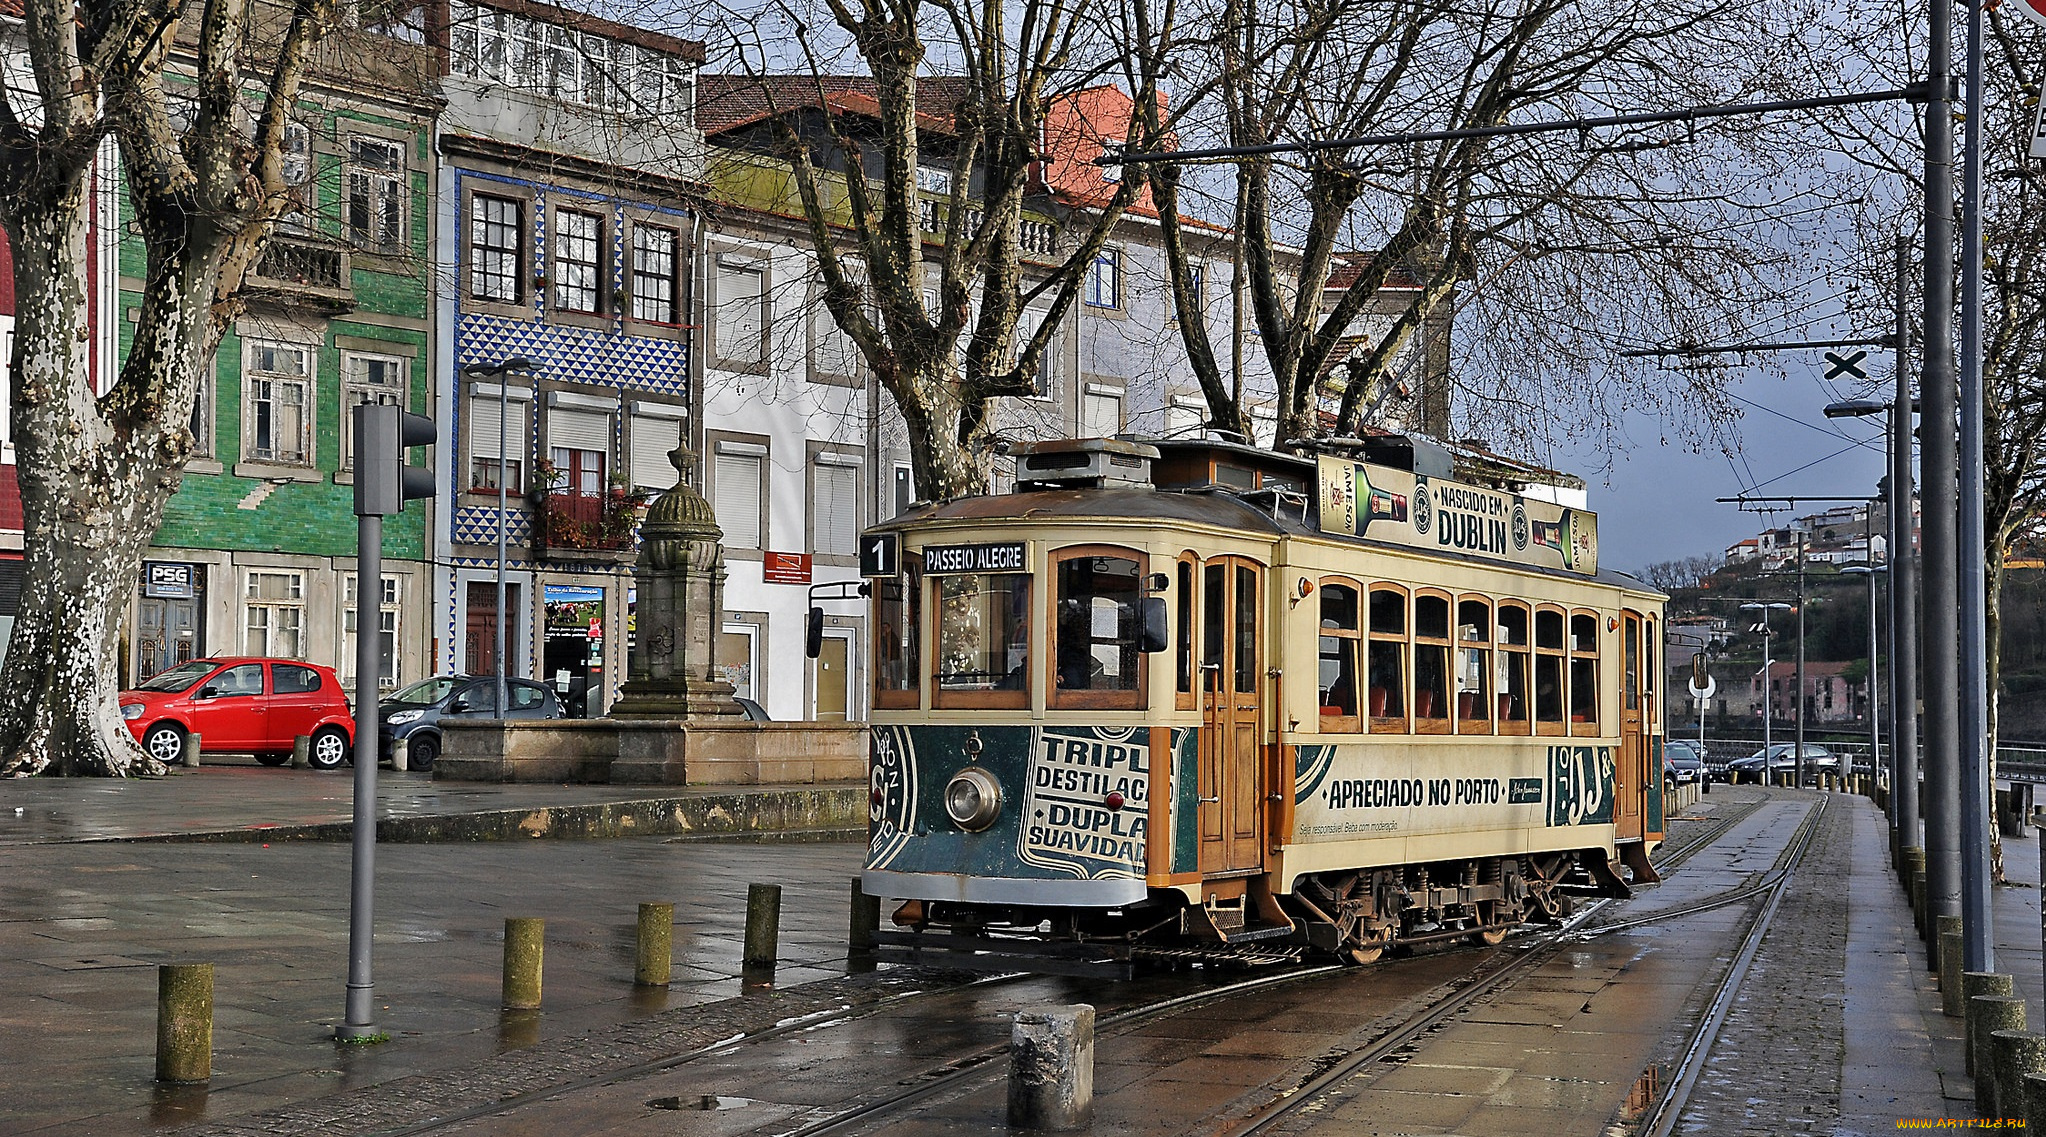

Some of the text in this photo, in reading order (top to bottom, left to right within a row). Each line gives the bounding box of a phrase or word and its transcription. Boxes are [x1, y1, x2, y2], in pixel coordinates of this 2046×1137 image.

[1343, 465, 1353, 532] JAMESON
[1440, 486, 1503, 517] NASCIDO EM
[1438, 509, 1506, 555] DUBLIN
[1572, 513, 1580, 569] JAMESON
[872, 540, 884, 571] 1
[926, 546, 1021, 570] PASSEIO ALEGRE
[152, 567, 188, 582] PSG
[1041, 737, 1174, 777] TRIPL
[1036, 766, 1174, 805] DESTILAÇ
[1329, 778, 1499, 809] APRECIADO NO PORTO
[1049, 804, 1148, 840] DUPLA
[1300, 823, 1311, 837] Seja
[1359, 823, 1370, 832] com
[1029, 826, 1147, 862] SUAVIDAD
